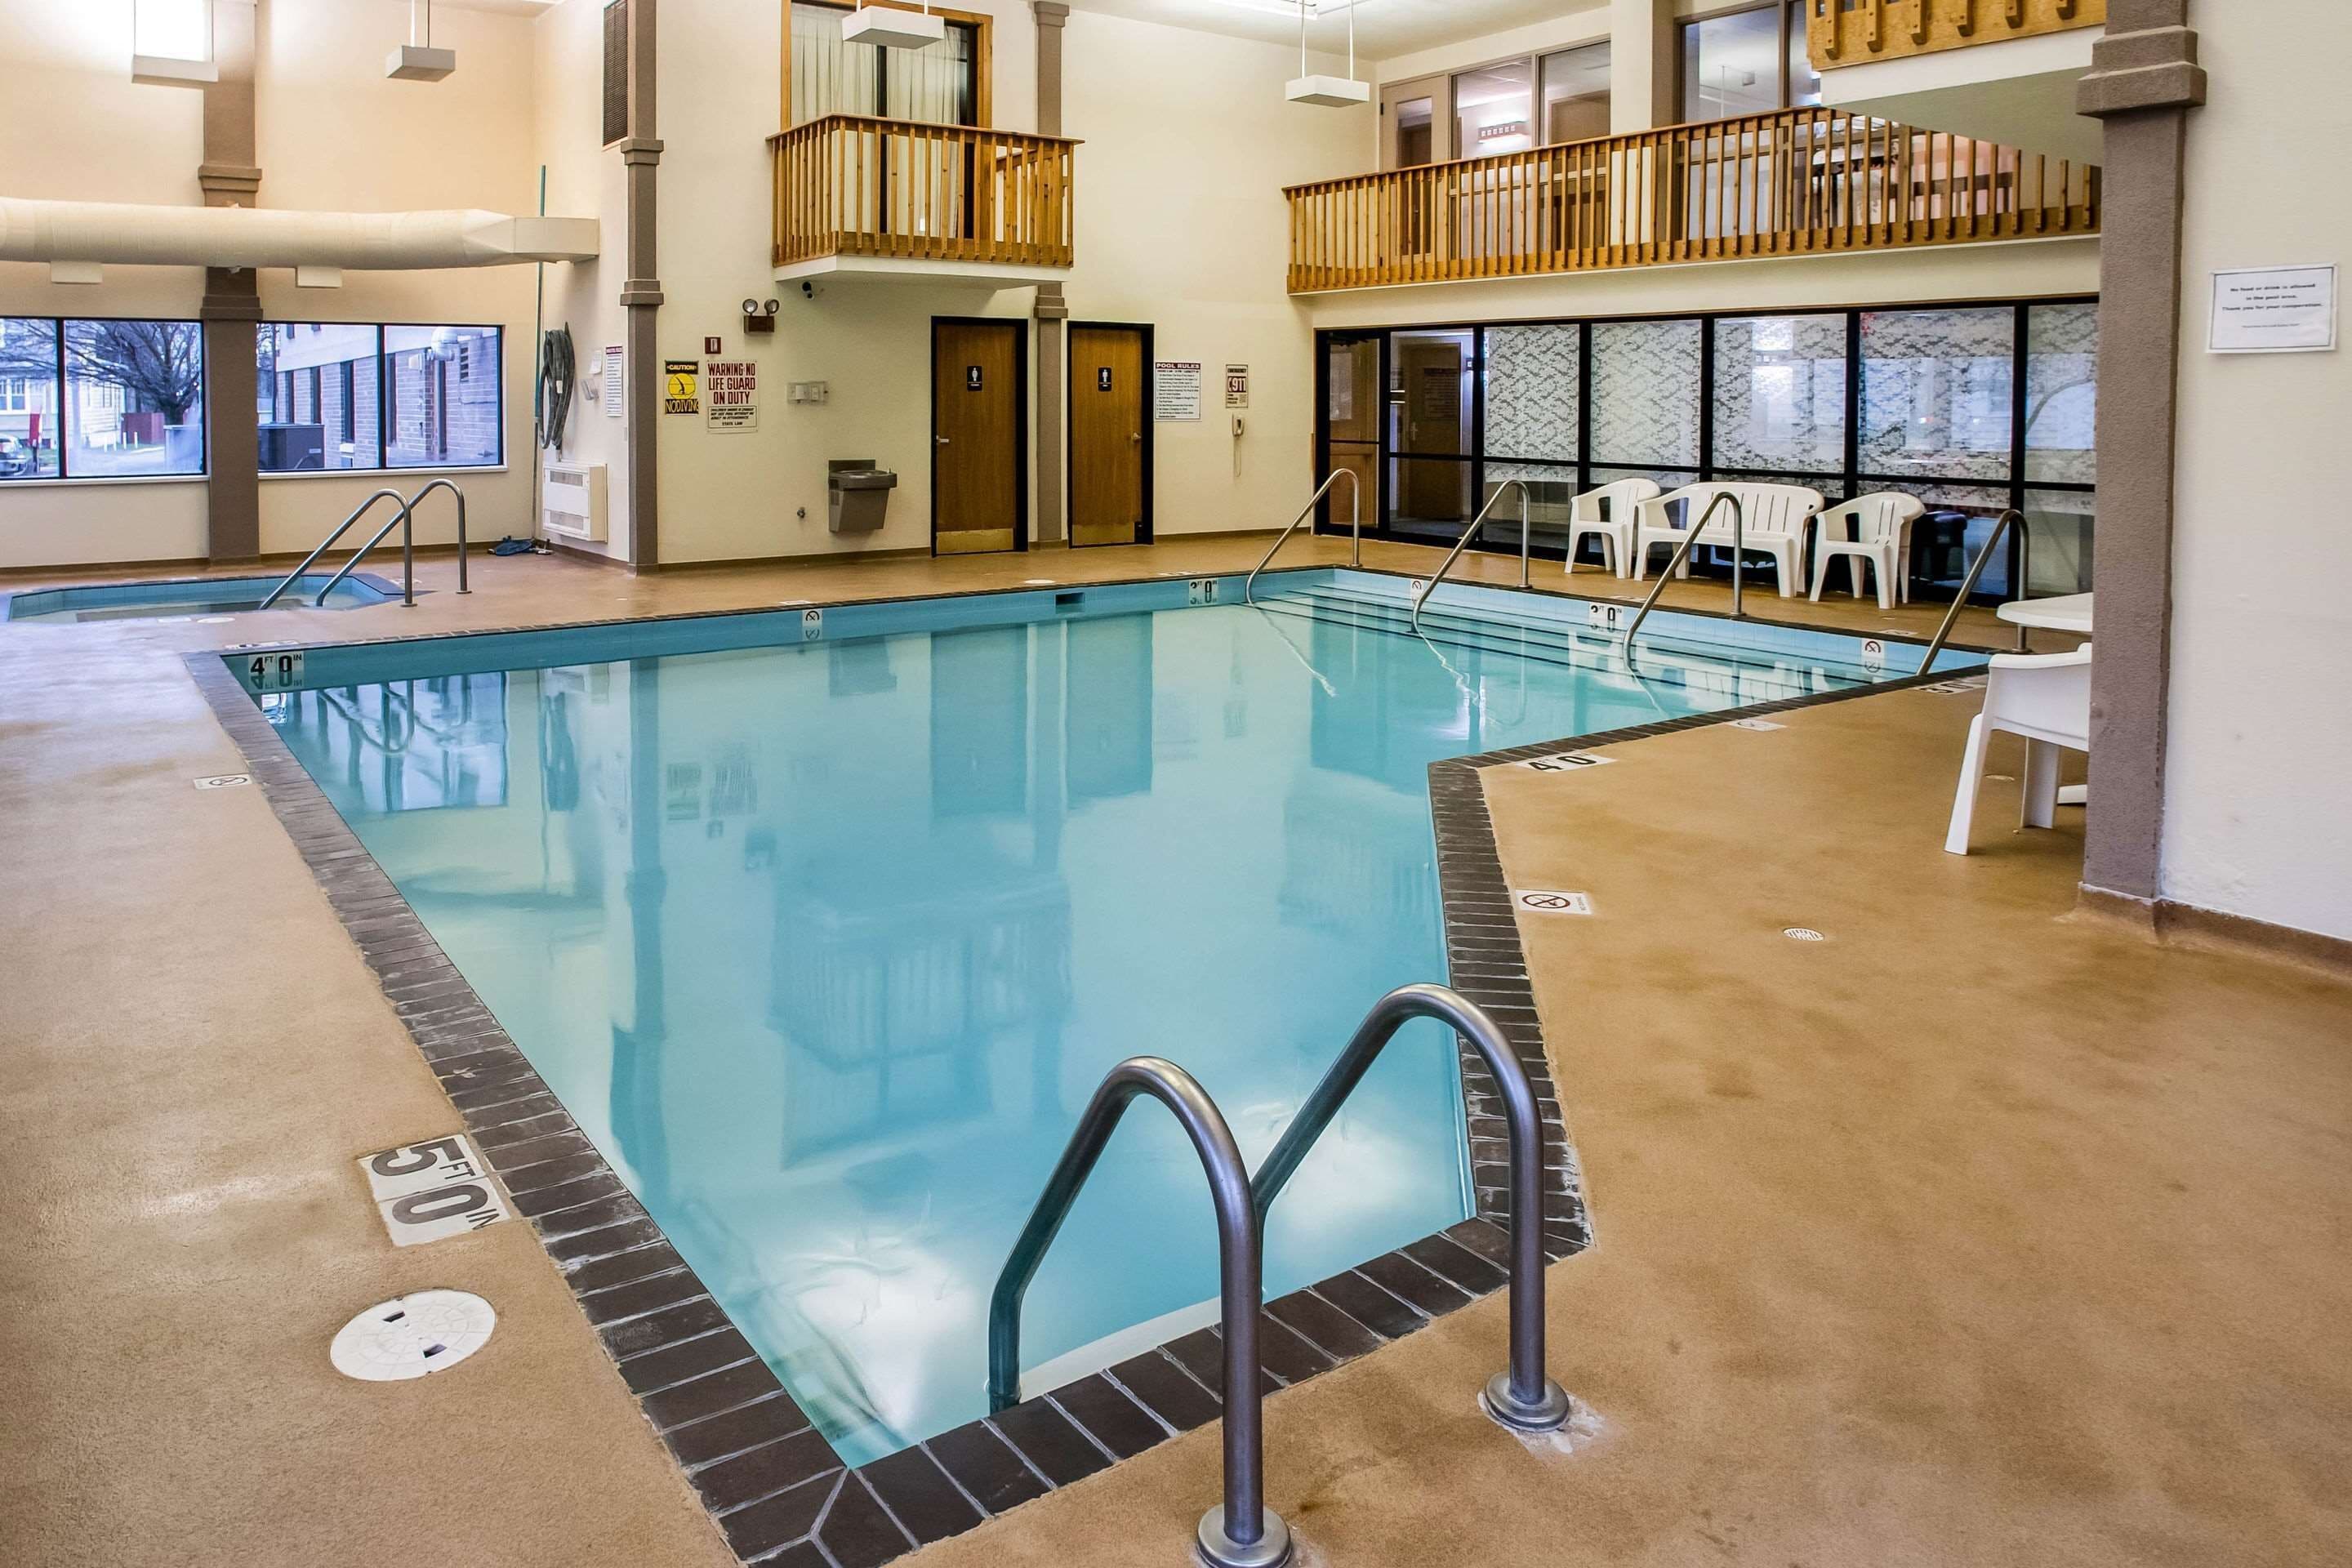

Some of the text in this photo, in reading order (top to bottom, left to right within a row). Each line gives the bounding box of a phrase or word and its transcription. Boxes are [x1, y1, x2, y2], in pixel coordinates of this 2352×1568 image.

[708, 363, 755, 376] WARNING NO
[708, 377, 755, 390] LIFE GUARD
[1232, 377, 1246, 392] 911
[713, 391, 750, 404] ON DUTY
[250, 657, 265, 675] 4
[265, 656, 274, 664] FT
[278, 655, 292, 672] 0
[1528, 762, 1564, 770] 4
[372, 1138, 476, 1179] 5 FT
[392, 1184, 500, 1231] 0 IN
